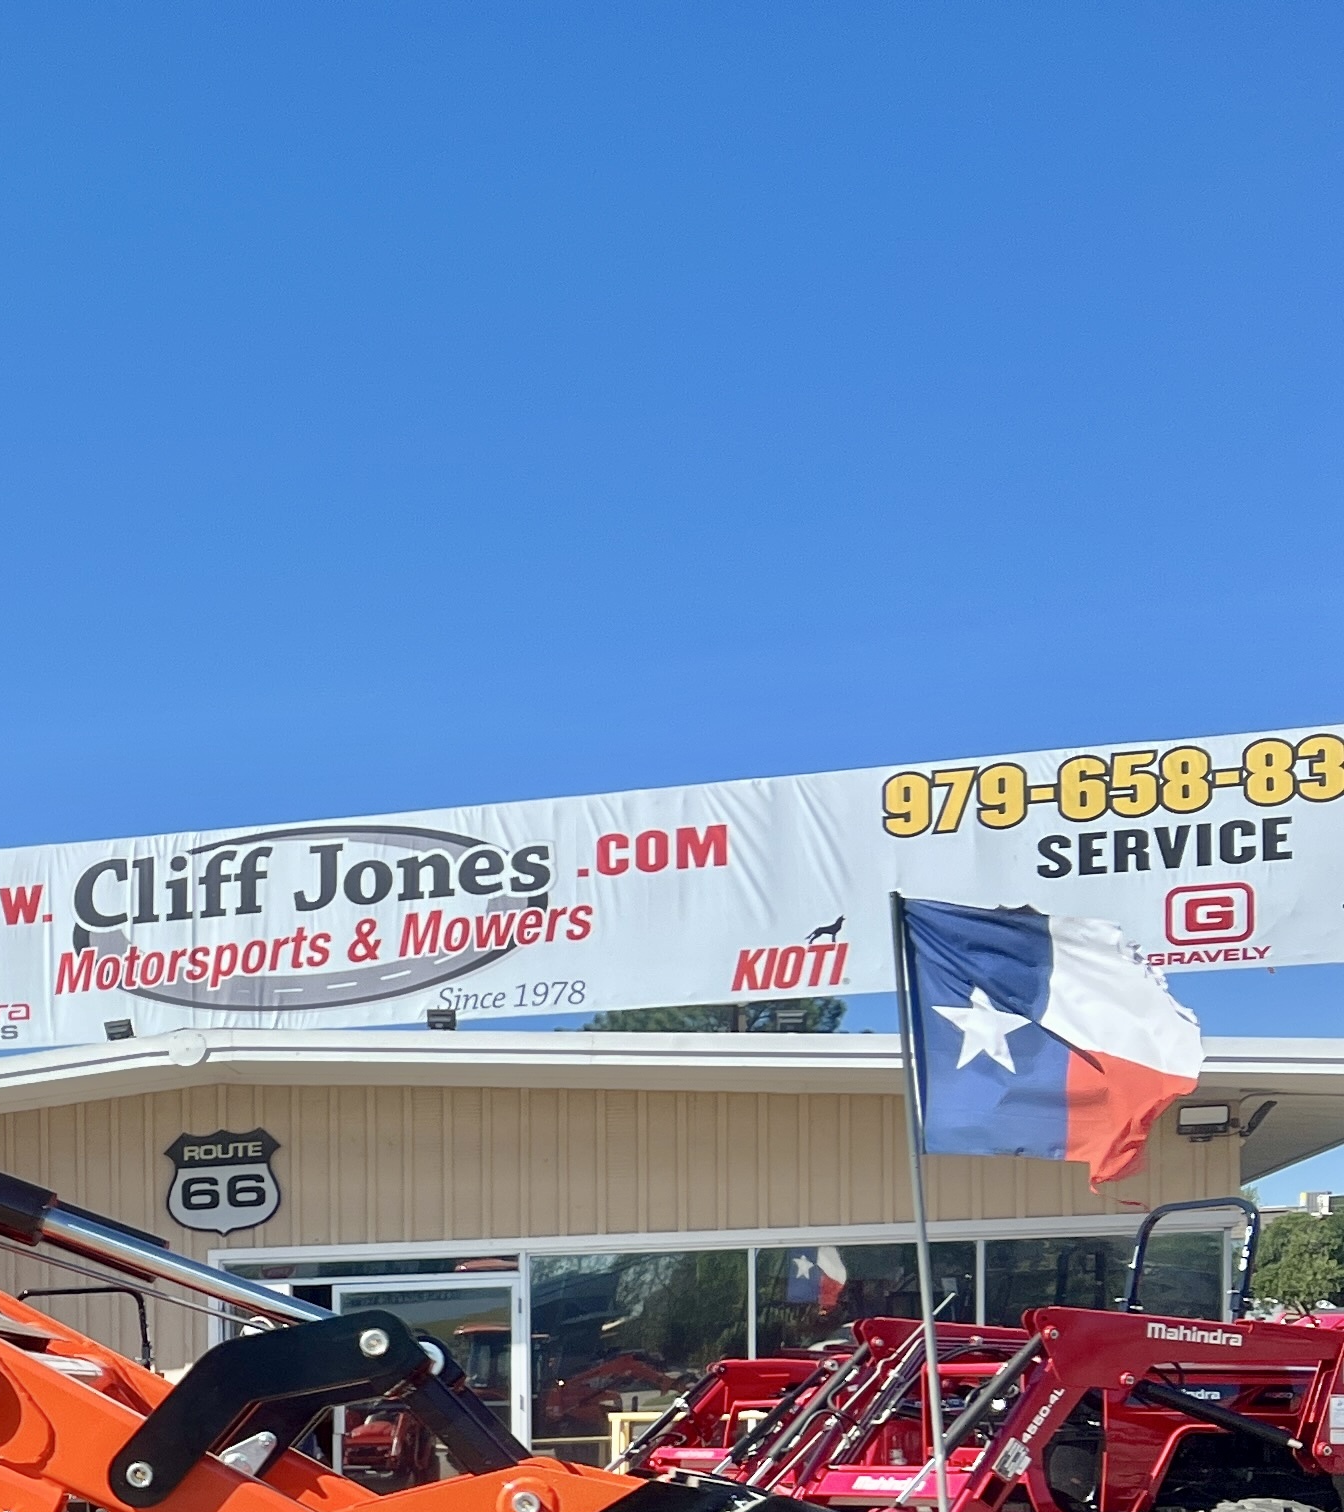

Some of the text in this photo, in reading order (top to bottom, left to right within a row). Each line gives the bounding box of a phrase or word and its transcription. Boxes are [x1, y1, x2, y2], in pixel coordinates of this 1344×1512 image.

[882, 733, 1344, 838] 979-658-83
[1036, 816, 1293, 879] SERVICE
[74, 846, 273, 929] Cliff
[293, 843, 551, 913] Jones
[577, 823, 728, 878] .COM
[55, 904, 593, 996] Motorsports & Mowers
[731, 941, 849, 992] KIOTI
[1148, 945, 1272, 966] GRAVELY
[437, 980, 586, 1012] Since 1978
[183, 1141, 263, 1161] ROUTE
[180, 1174, 267, 1211] 66
[1147, 1322, 1242, 1347] Mahindra
